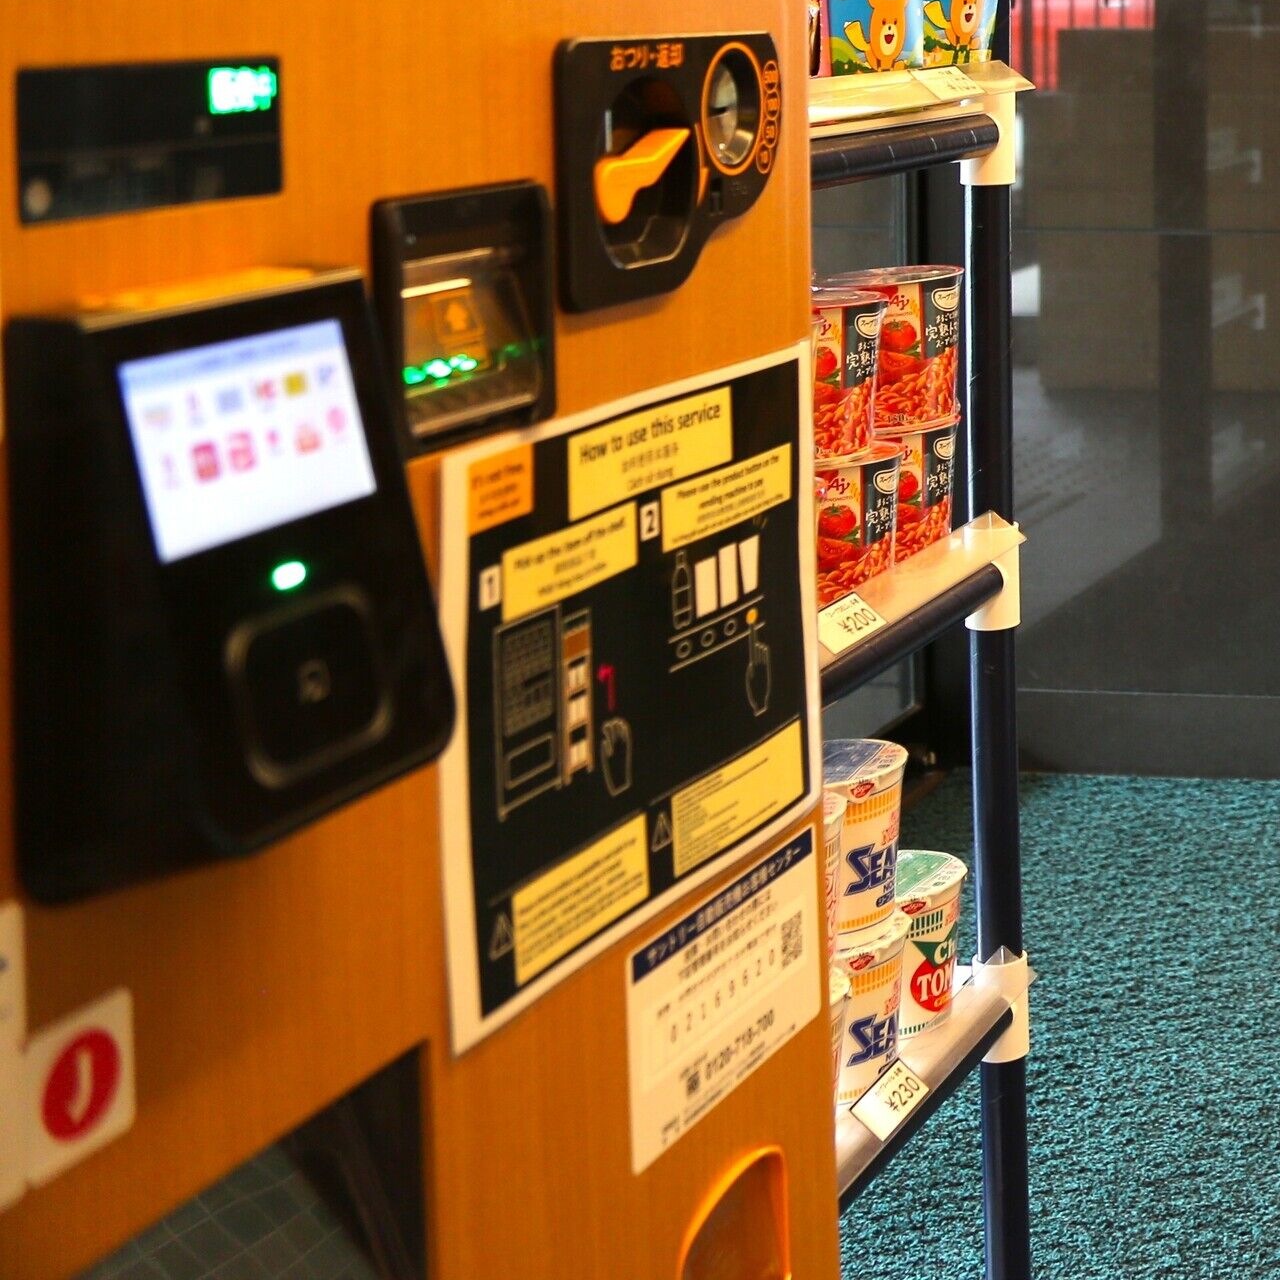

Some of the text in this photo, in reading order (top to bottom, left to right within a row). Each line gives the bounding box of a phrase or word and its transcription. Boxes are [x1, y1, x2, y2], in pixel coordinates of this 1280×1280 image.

[579, 441, 608, 465] How
[610, 435, 625, 455] to
[627, 431, 649, 451] use
[650, 415, 675, 443] this
[677, 401, 722, 431] service
[644, 512, 656, 533] 2
[485, 576, 498, 601] 1
[836, 607, 877, 635] ¥200
[884, 1075, 921, 1112] ¥230
